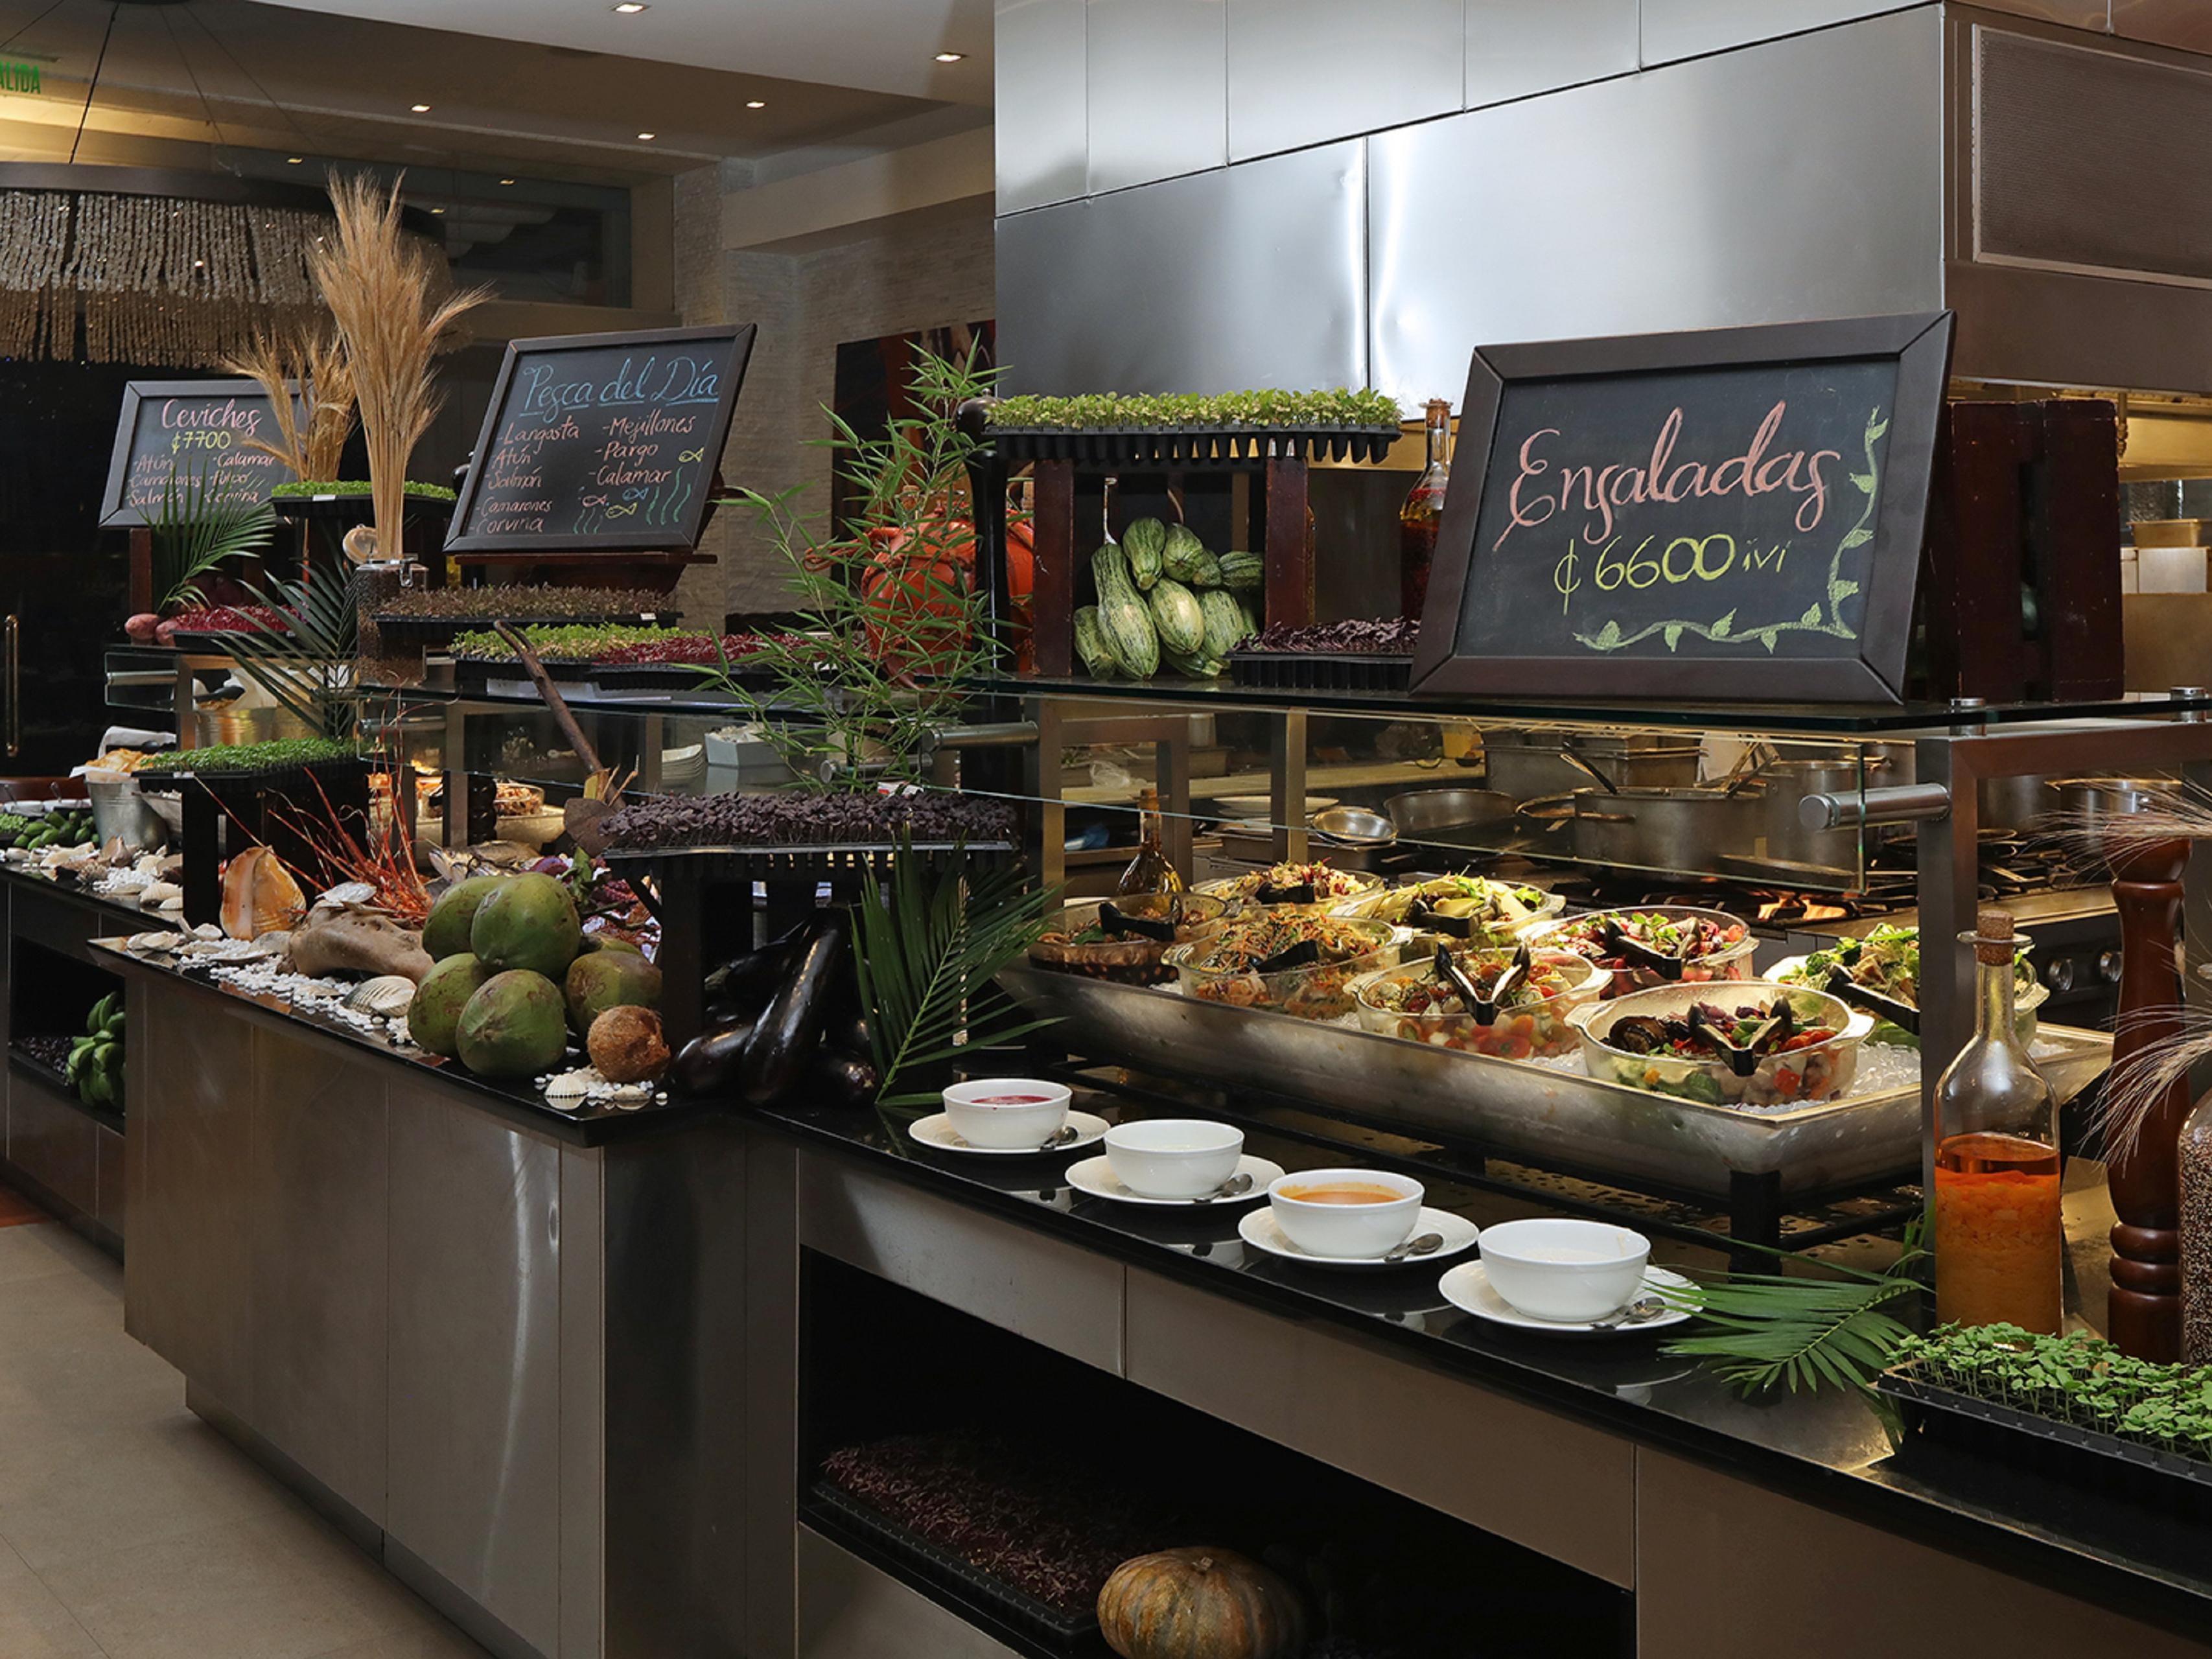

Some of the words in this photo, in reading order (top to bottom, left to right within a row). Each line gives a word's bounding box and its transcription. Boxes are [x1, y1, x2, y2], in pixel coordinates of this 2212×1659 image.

[162, 399, 262, 436] Ceviches
[523, 364, 594, 423] Pesca
[600, 356, 655, 402] del
[650, 356, 718, 400] Día
[1492, 400, 1841, 551] Ensaladas
